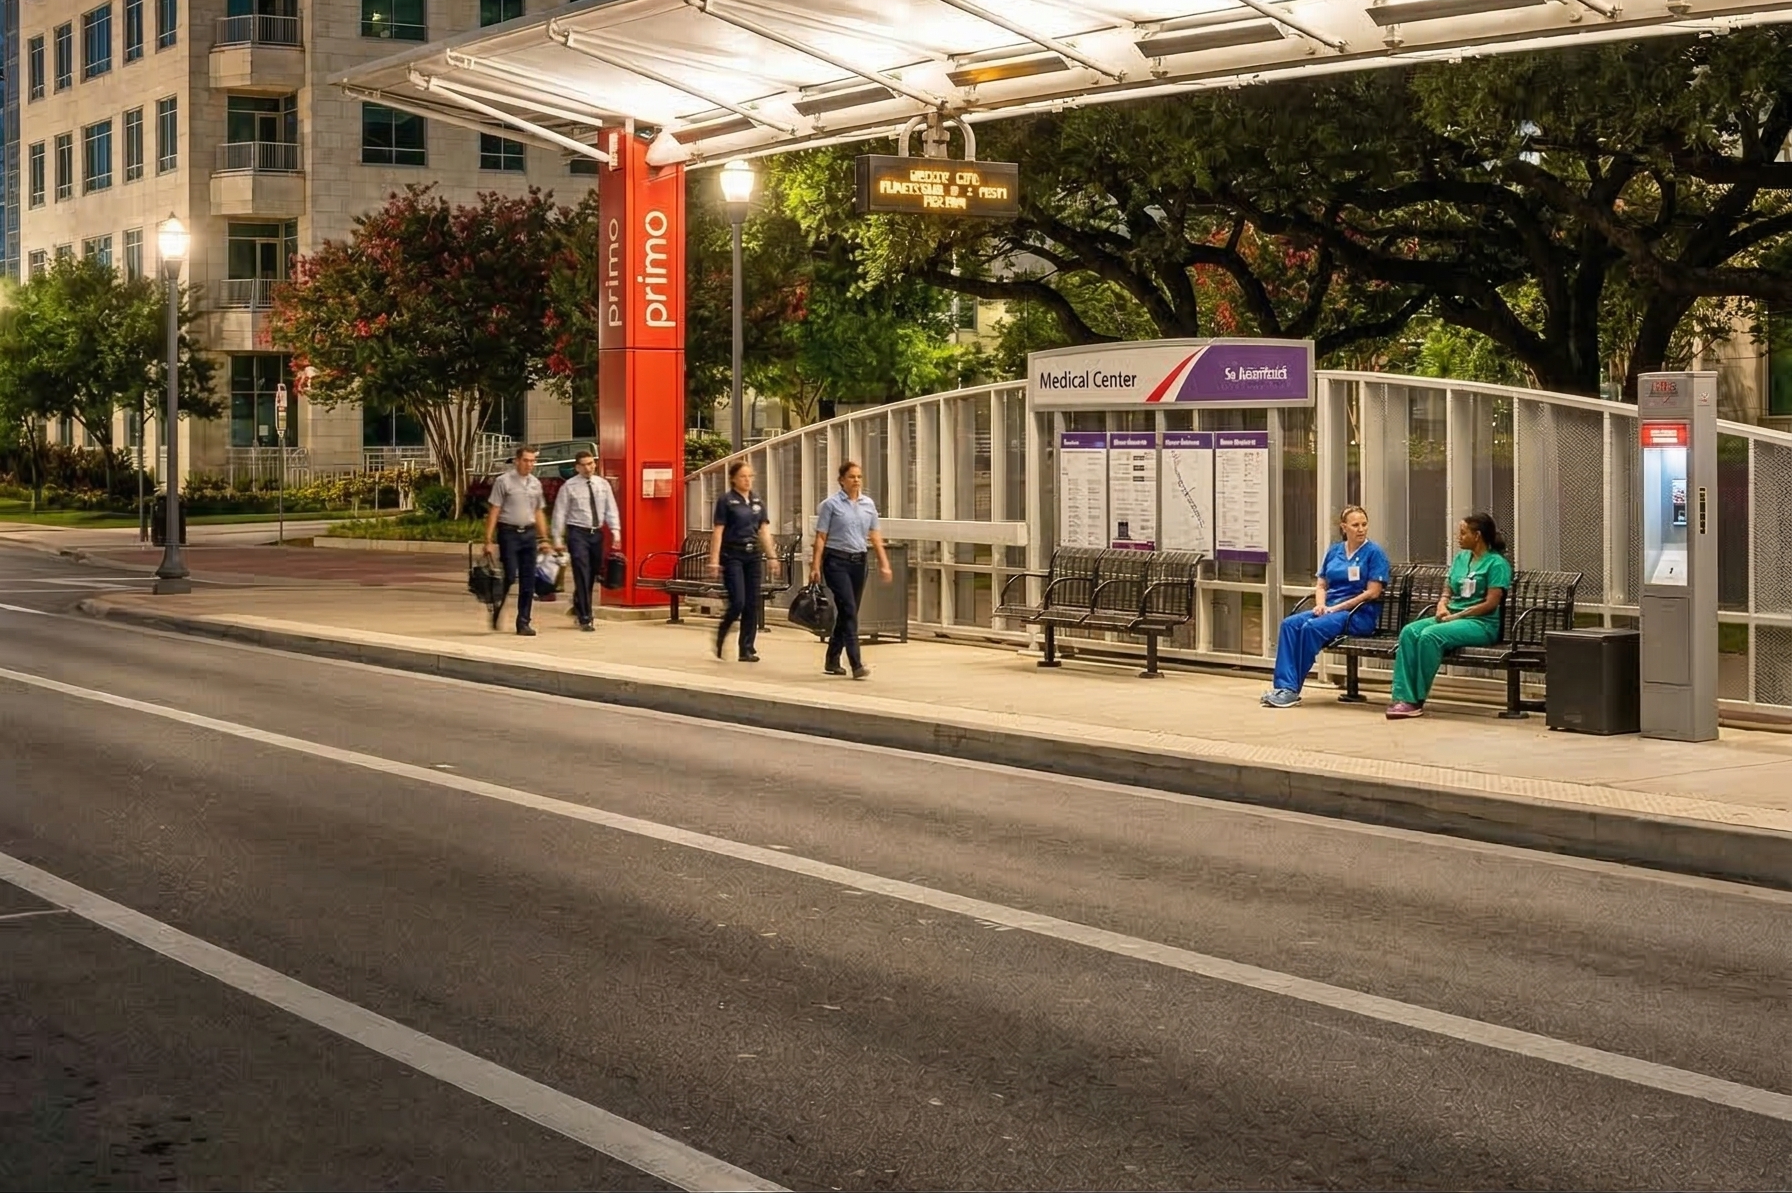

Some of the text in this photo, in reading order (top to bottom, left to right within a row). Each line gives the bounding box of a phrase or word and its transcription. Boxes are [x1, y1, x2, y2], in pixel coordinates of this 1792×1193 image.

[605, 218, 622, 327] primo
[637, 210, 676, 328] primo
[1040, 370, 1137, 389] Medical Center
